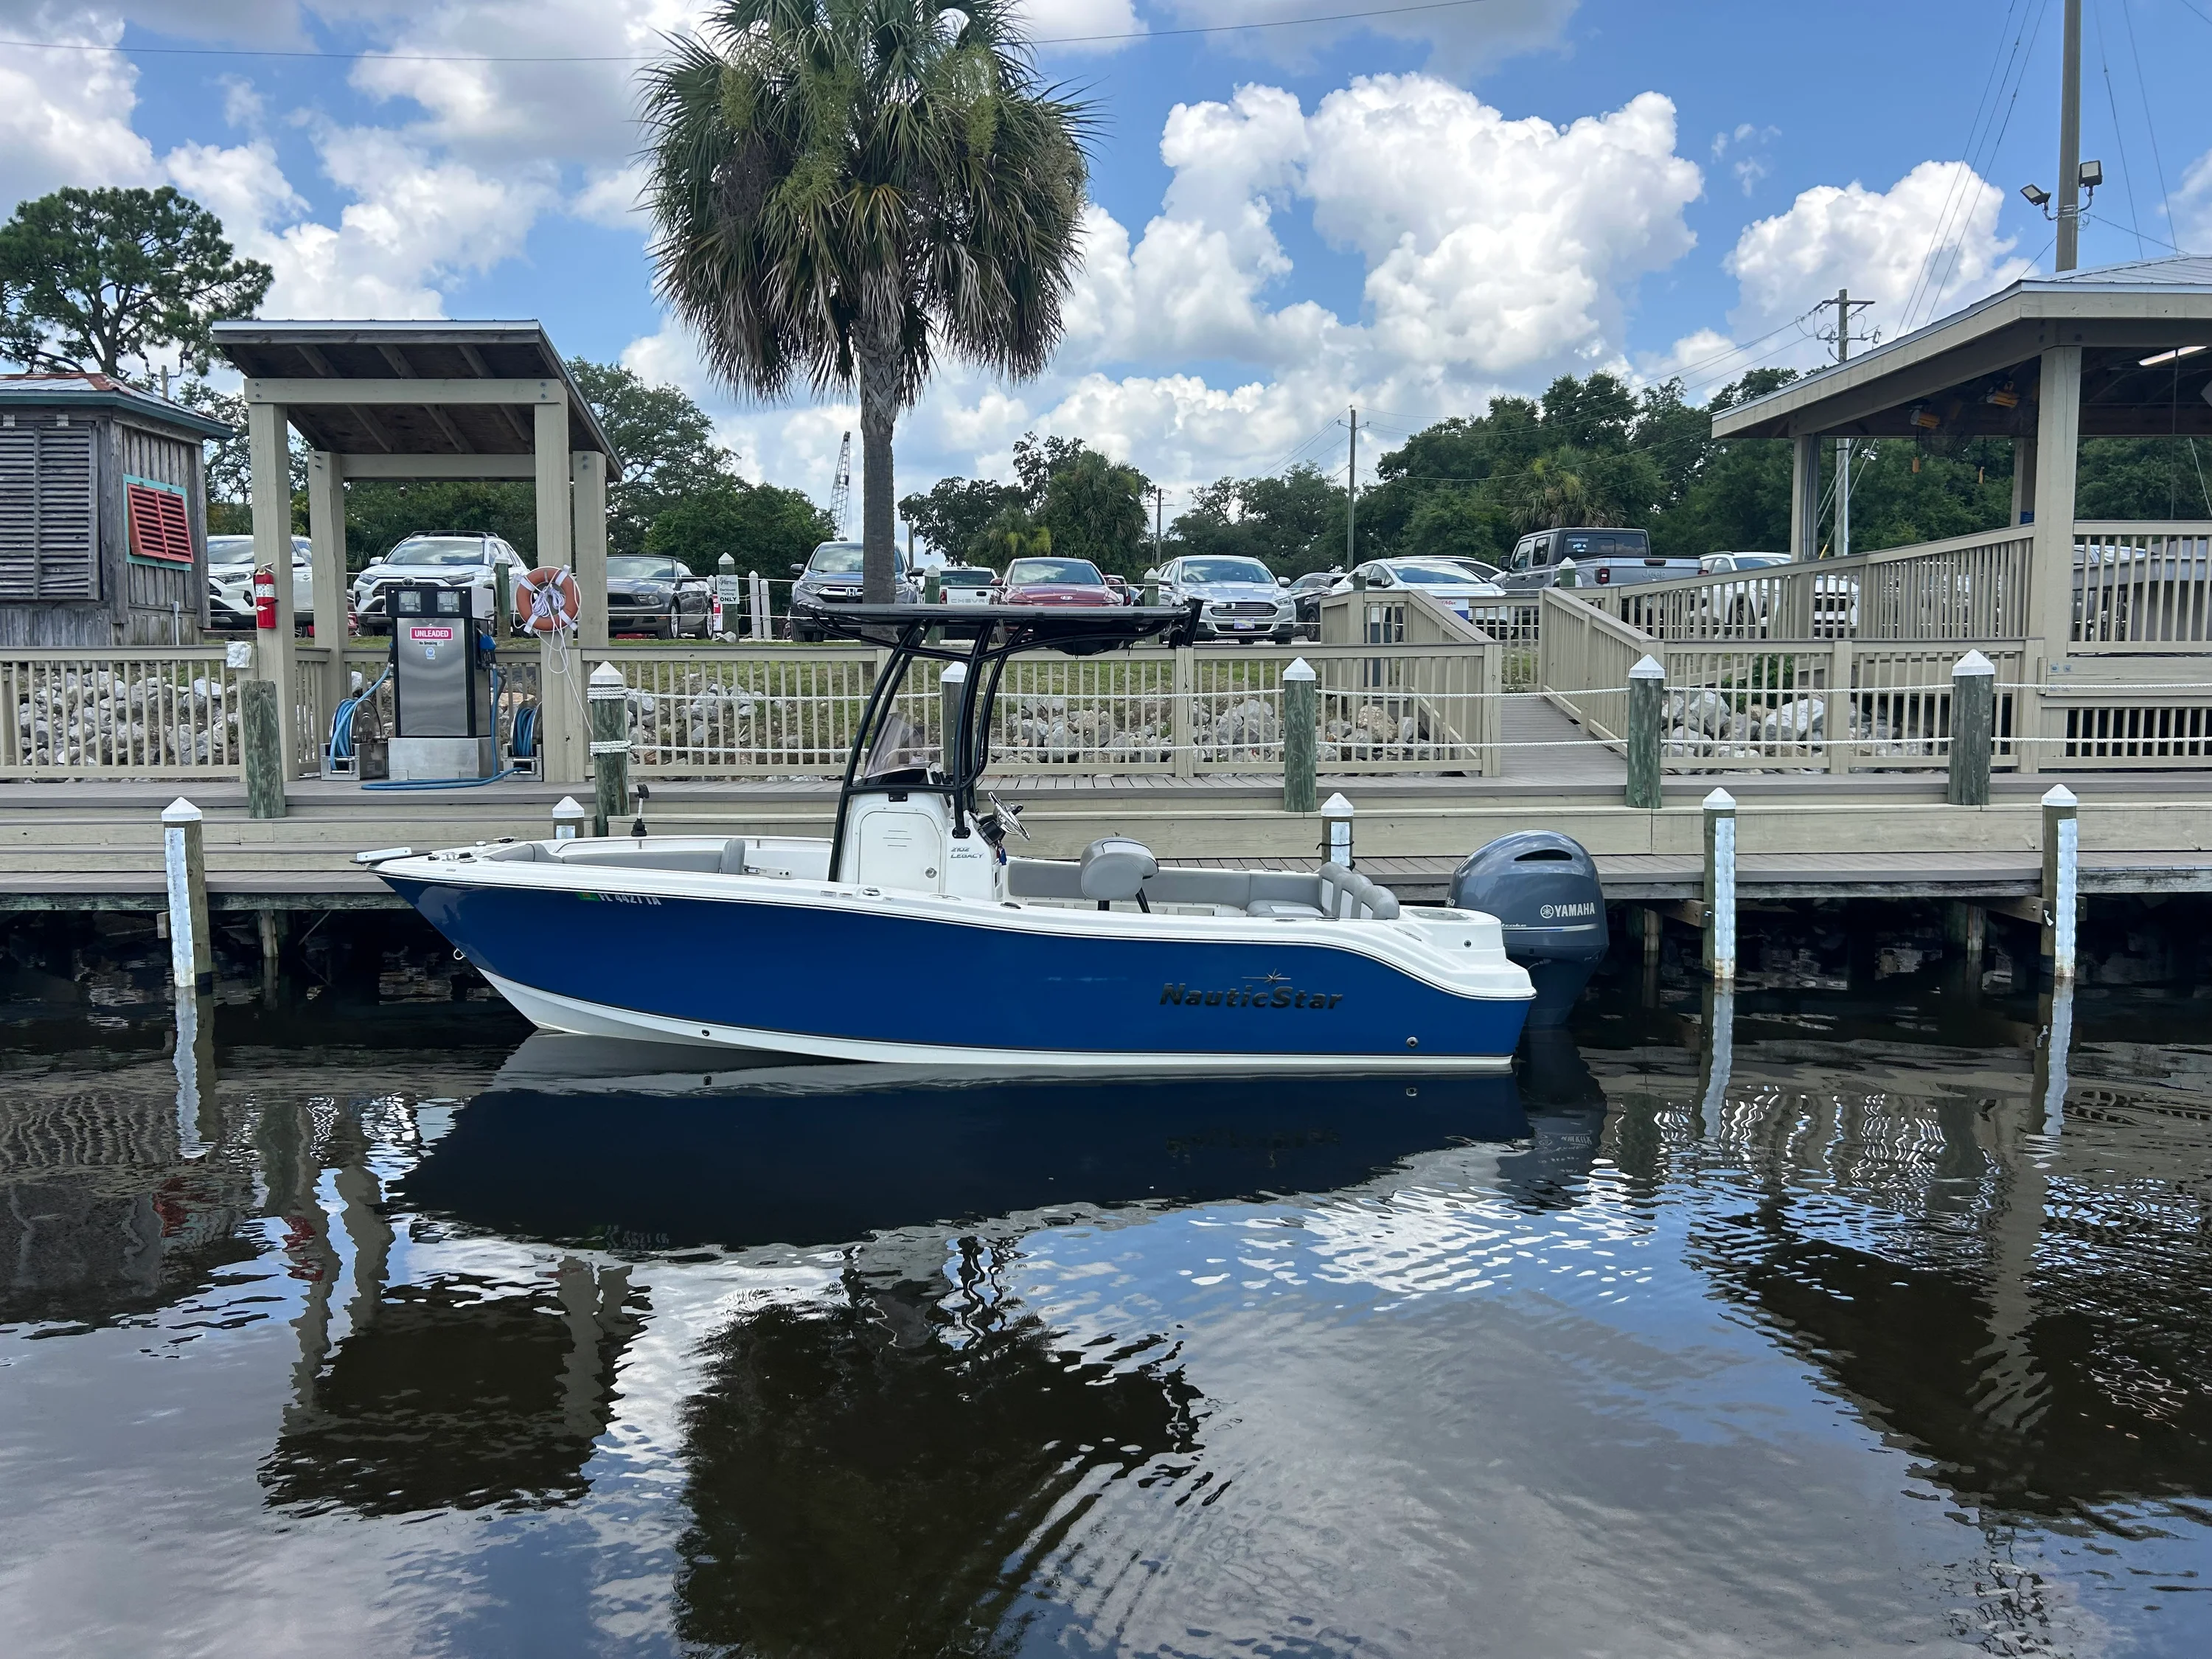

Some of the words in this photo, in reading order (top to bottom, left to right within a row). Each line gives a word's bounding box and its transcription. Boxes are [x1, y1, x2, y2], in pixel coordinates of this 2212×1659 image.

[1642, 568, 1666, 580] Jeep
[1554, 902, 1595, 917] YAMAHA
[1160, 983, 1343, 1009] NauticStar
